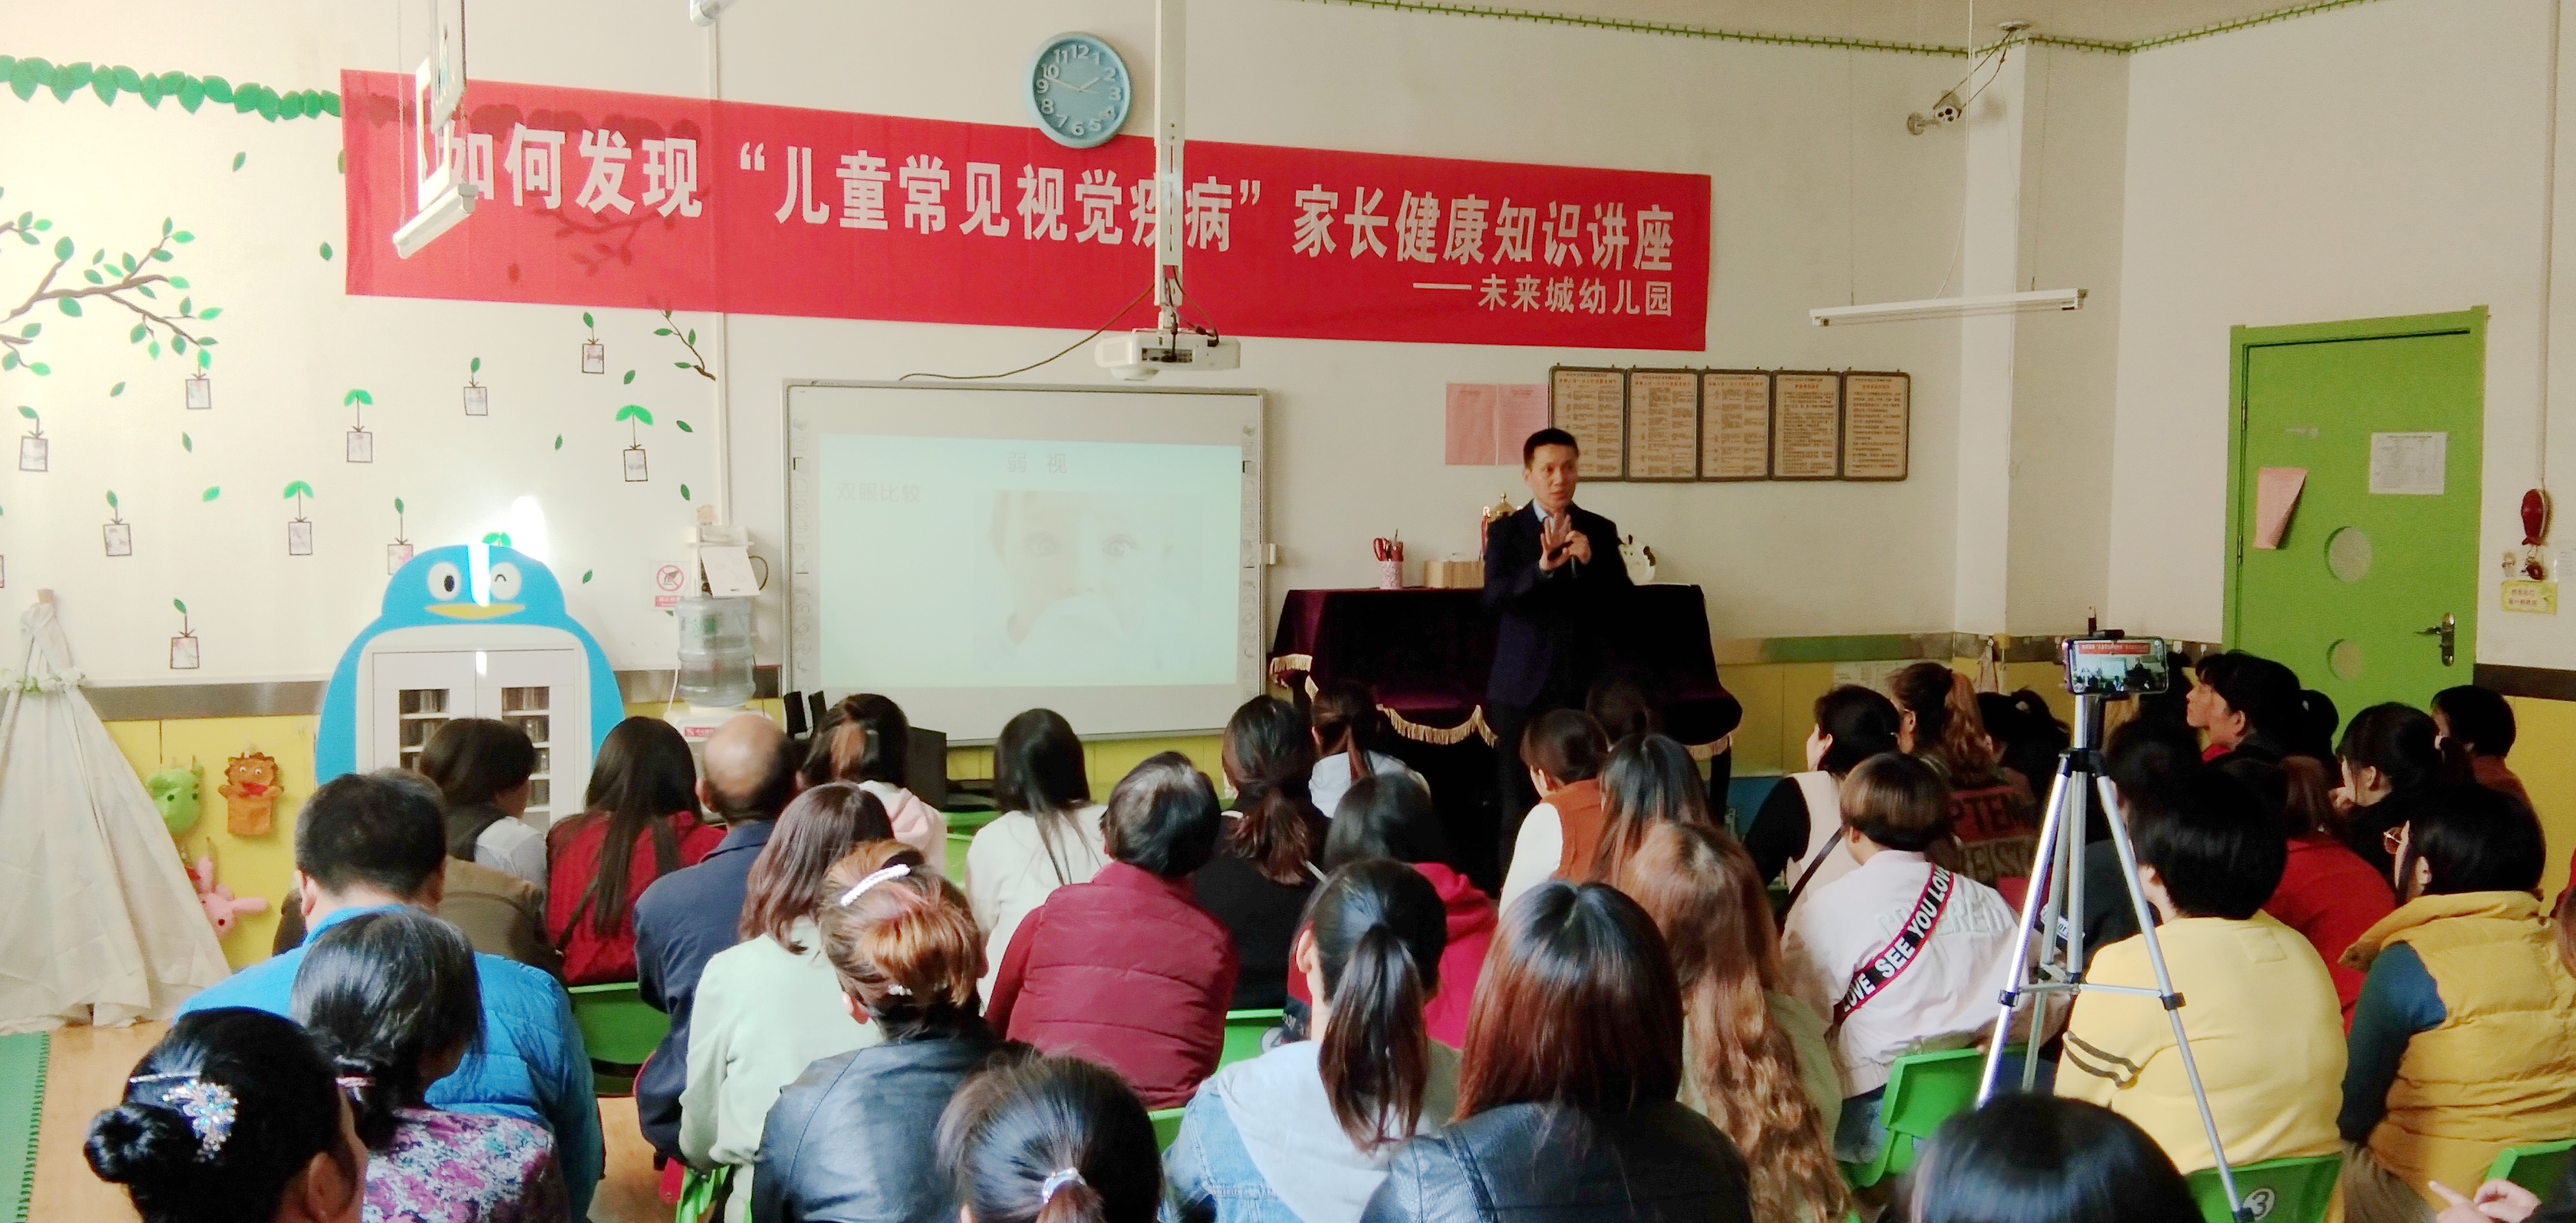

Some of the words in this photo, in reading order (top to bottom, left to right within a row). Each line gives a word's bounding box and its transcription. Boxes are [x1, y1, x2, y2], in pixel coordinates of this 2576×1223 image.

[1054, 49, 1067, 64] 11
[1071, 44, 1089, 59] 12
[1092, 52, 1100, 65] 1
[1041, 63, 1059, 79] 10
[1036, 79, 1049, 93] 9
[1041, 99, 1054, 114] 8
[1056, 115, 1068, 128] 7
[1072, 122, 1084, 135] 6
[1090, 119, 1102, 131] 5
[1875, 937, 1916, 978] SEE
[1907, 898, 1938, 939] YOU
[2252, 1191, 2269, 1217] 3
